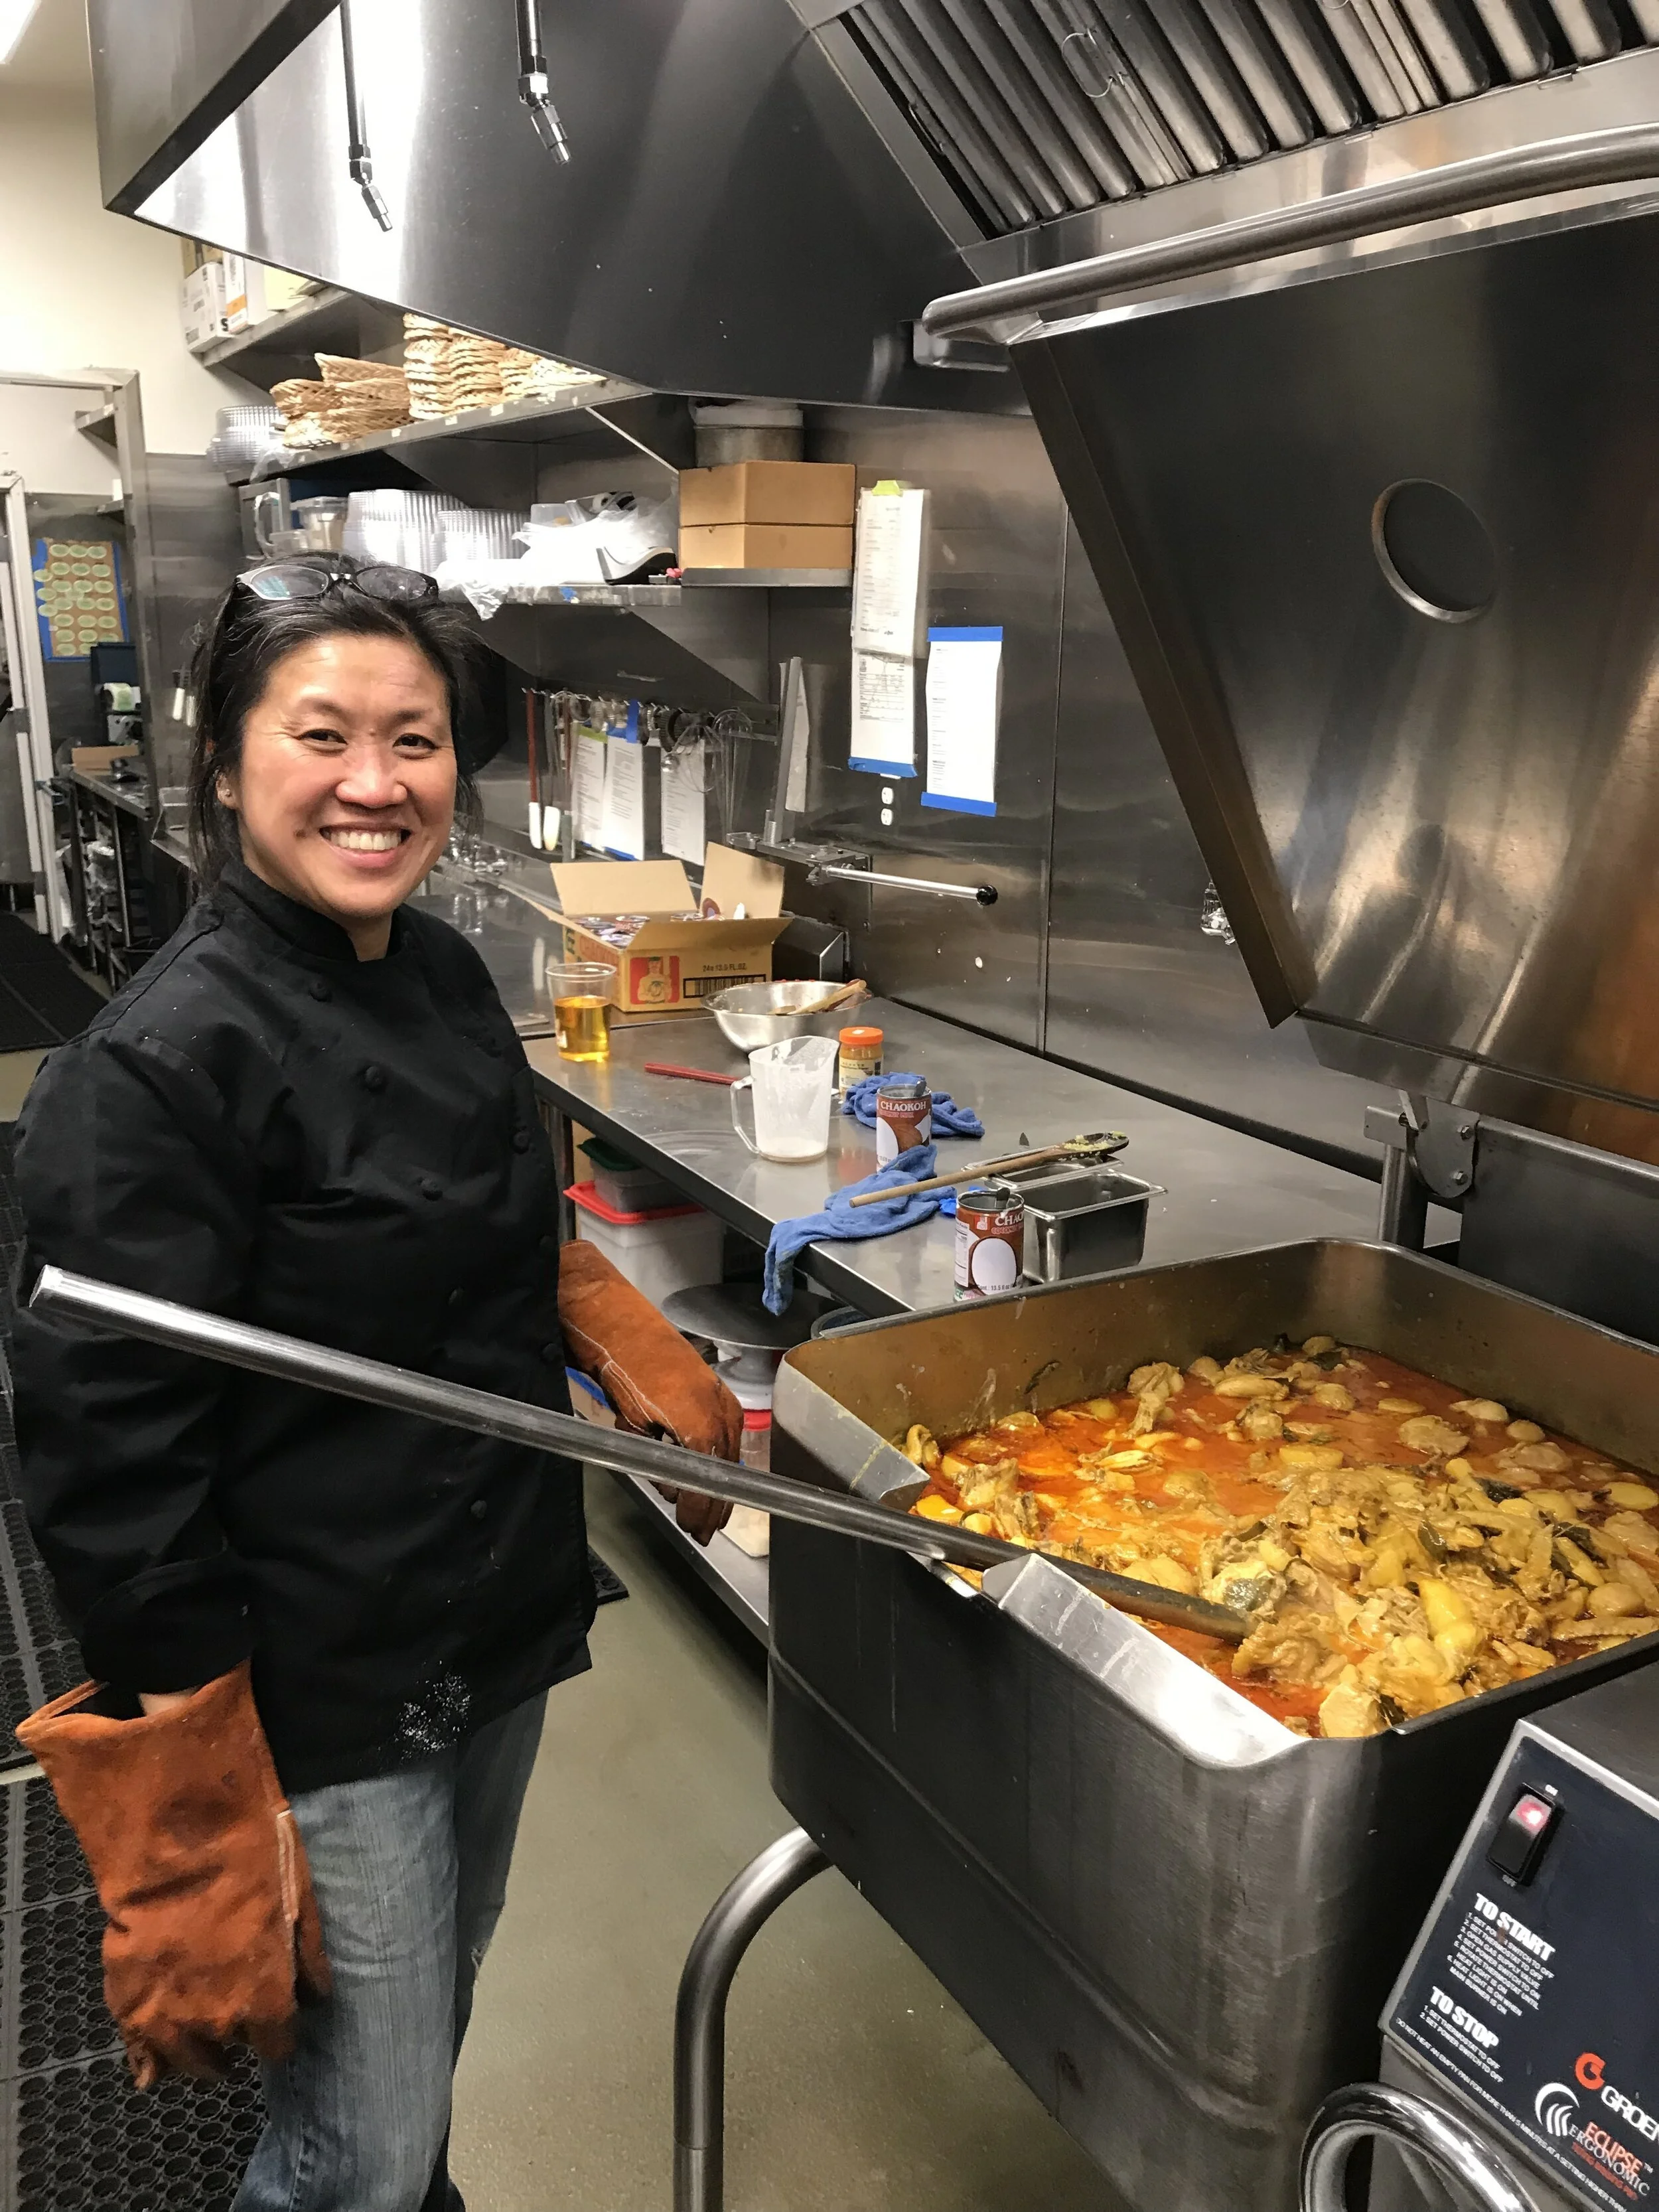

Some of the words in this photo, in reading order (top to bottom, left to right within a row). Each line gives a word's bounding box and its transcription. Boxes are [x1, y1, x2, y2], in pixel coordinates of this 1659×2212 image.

[881, 1101, 926, 1111] CHAOKOH
[1470, 1923, 1482, 1935] SET
[1482, 1932, 1521, 1964] THERMOSTAT
[1521, 1961, 1530, 1971] TO
[1529, 1969, 1544, 1980] OFF
[1473, 1917, 1486, 1927] SET
[1507, 1942, 1532, 1963] SWITCH
[1532, 1960, 1541, 1969] TO
[1540, 1967, 1554, 1978] OFF
[1475, 1893, 1499, 1921] TO
[1496, 1912, 1555, 1961] START
[1453, 1959, 1469, 1974] HEAT
[1469, 1971, 1488, 1988] LIGHT
[1493, 1991, 1504, 2002] ON
[1503, 1998, 1522, 2016] WHEN
[1456, 1952, 1473, 1966] HEAT
[1472, 1964, 1491, 1981] LIGHT
[1497, 1984, 1508, 1994] ON
[1460, 1945, 1483, 1965] ROTATE
[1482, 1962, 1523, 1994] THERMOSTAT
[1521, 1992, 1539, 2010] UNTIL
[1463, 1938, 1476, 1949] SET
[1475, 1947, 1499, 1967] POWER
[1497, 1964, 1522, 1985] SWITCH
[1521, 1982, 1530, 1992] TO
[1530, 1989, 1541, 2000] ON
[1467, 1931, 1484, 1947] OPEN
[1483, 1944, 1498, 1956] GAS
[1497, 1954, 1521, 1974] SUPPLY
[1520, 1971, 1540, 1989] VALVE
[1430, 1986, 1454, 2014] TO
[1451, 2006, 1499, 2048] STOP
[1449, 1966, 1466, 1981] MAIN
[1496, 2004, 1507, 2014] ON
[1404, 2025, 1417, 2037] NOT
[1417, 2035, 1432, 2050] HEAT
[1425, 2017, 1438, 2028] SET
[1437, 2026, 1459, 2047] POWER
[1459, 2044, 1482, 2066] SWITCH
[1480, 2063, 1490, 2073] TO
[1490, 2071, 1504, 2082] OFF
[1429, 2010, 1441, 2021] SET
[1441, 2018, 1479, 2052] THERMOSTAT
[1478, 2049, 1487, 2059] TO
[1486, 2057, 1500, 2069] OFF
[1568, 2124, 1650, 2196] ERGONOMIC
[1585, 2121, 1642, 2174] ECLIPSE
